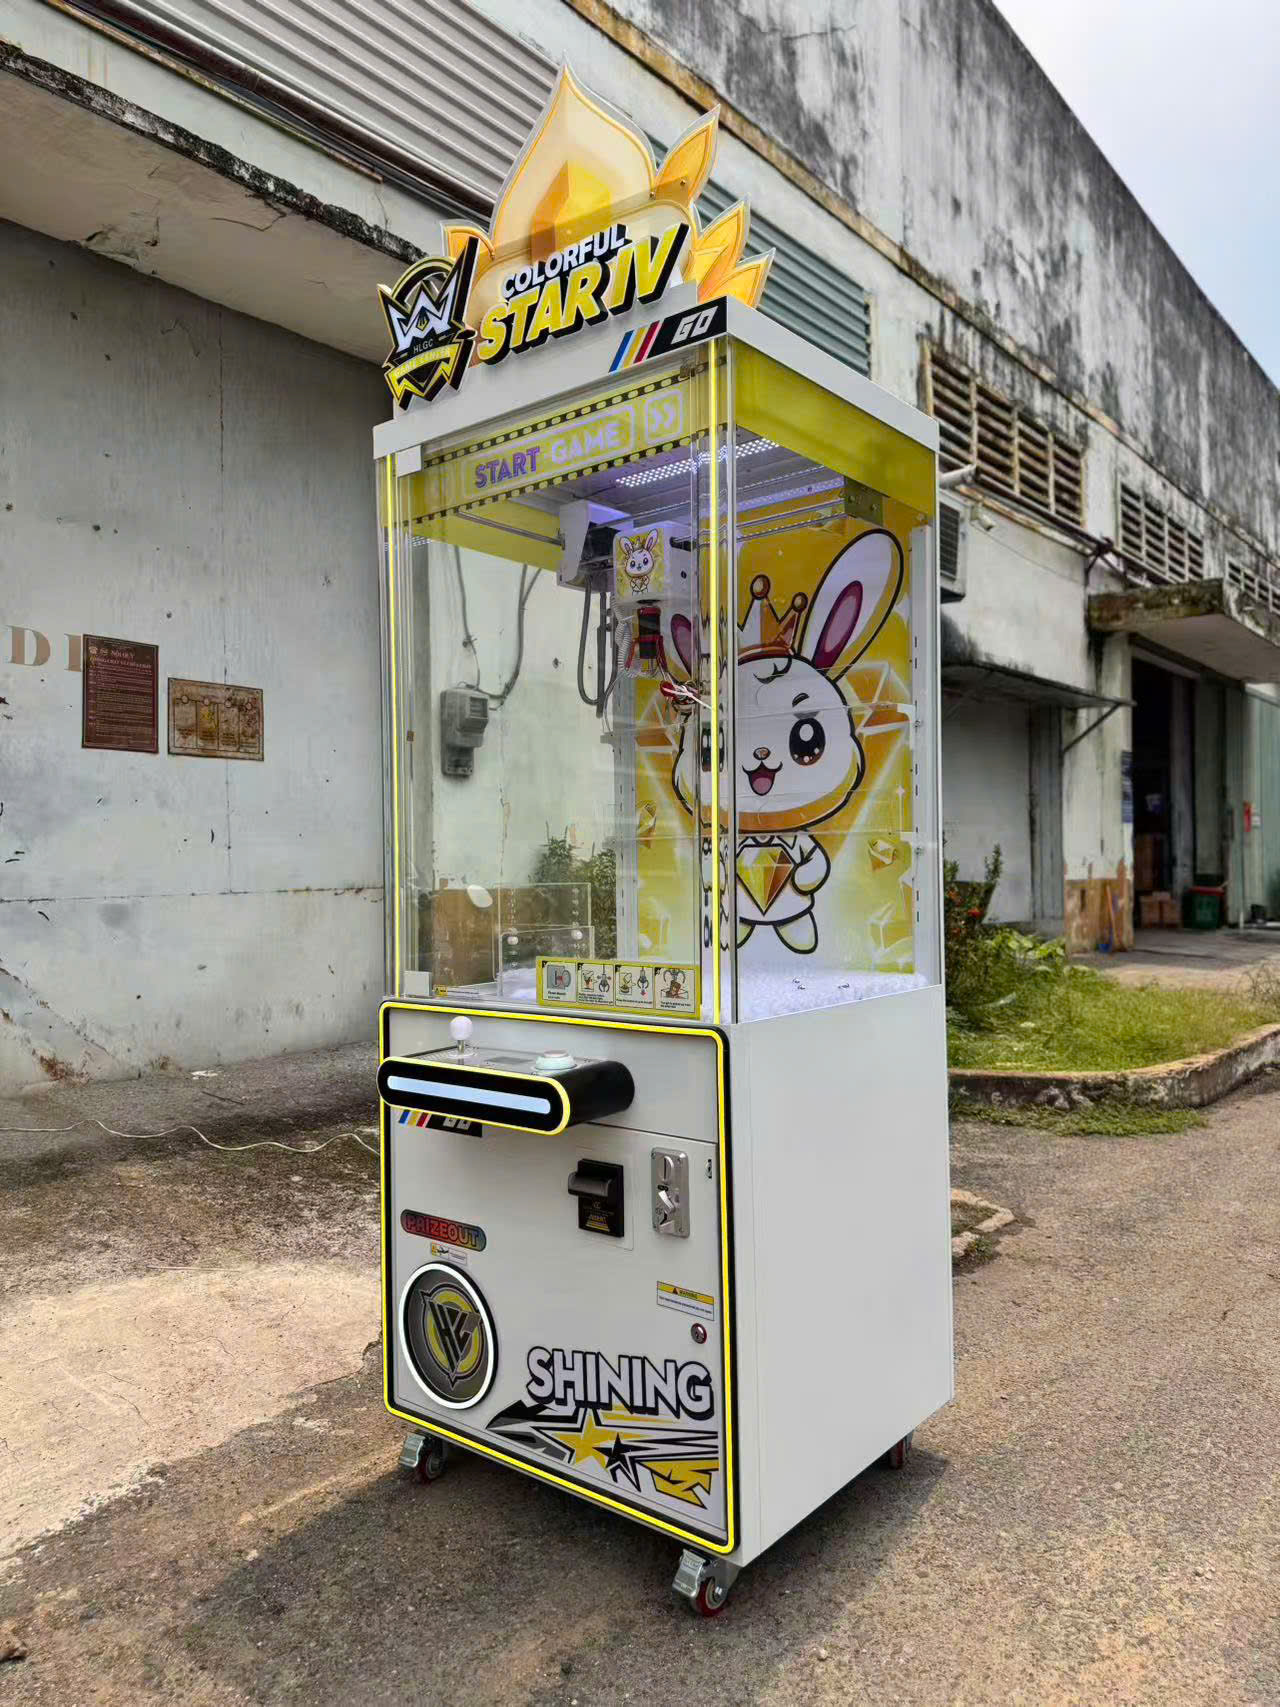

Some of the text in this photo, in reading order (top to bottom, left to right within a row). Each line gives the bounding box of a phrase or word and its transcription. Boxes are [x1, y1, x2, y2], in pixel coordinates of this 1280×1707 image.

[501, 223, 630, 299] COLORFUL
[670, 305, 719, 345] GO
[475, 420, 622, 489] START GAME
[405, 1212, 480, 1247] PRIZEOUT
[526, 1345, 715, 1421] SHINING
